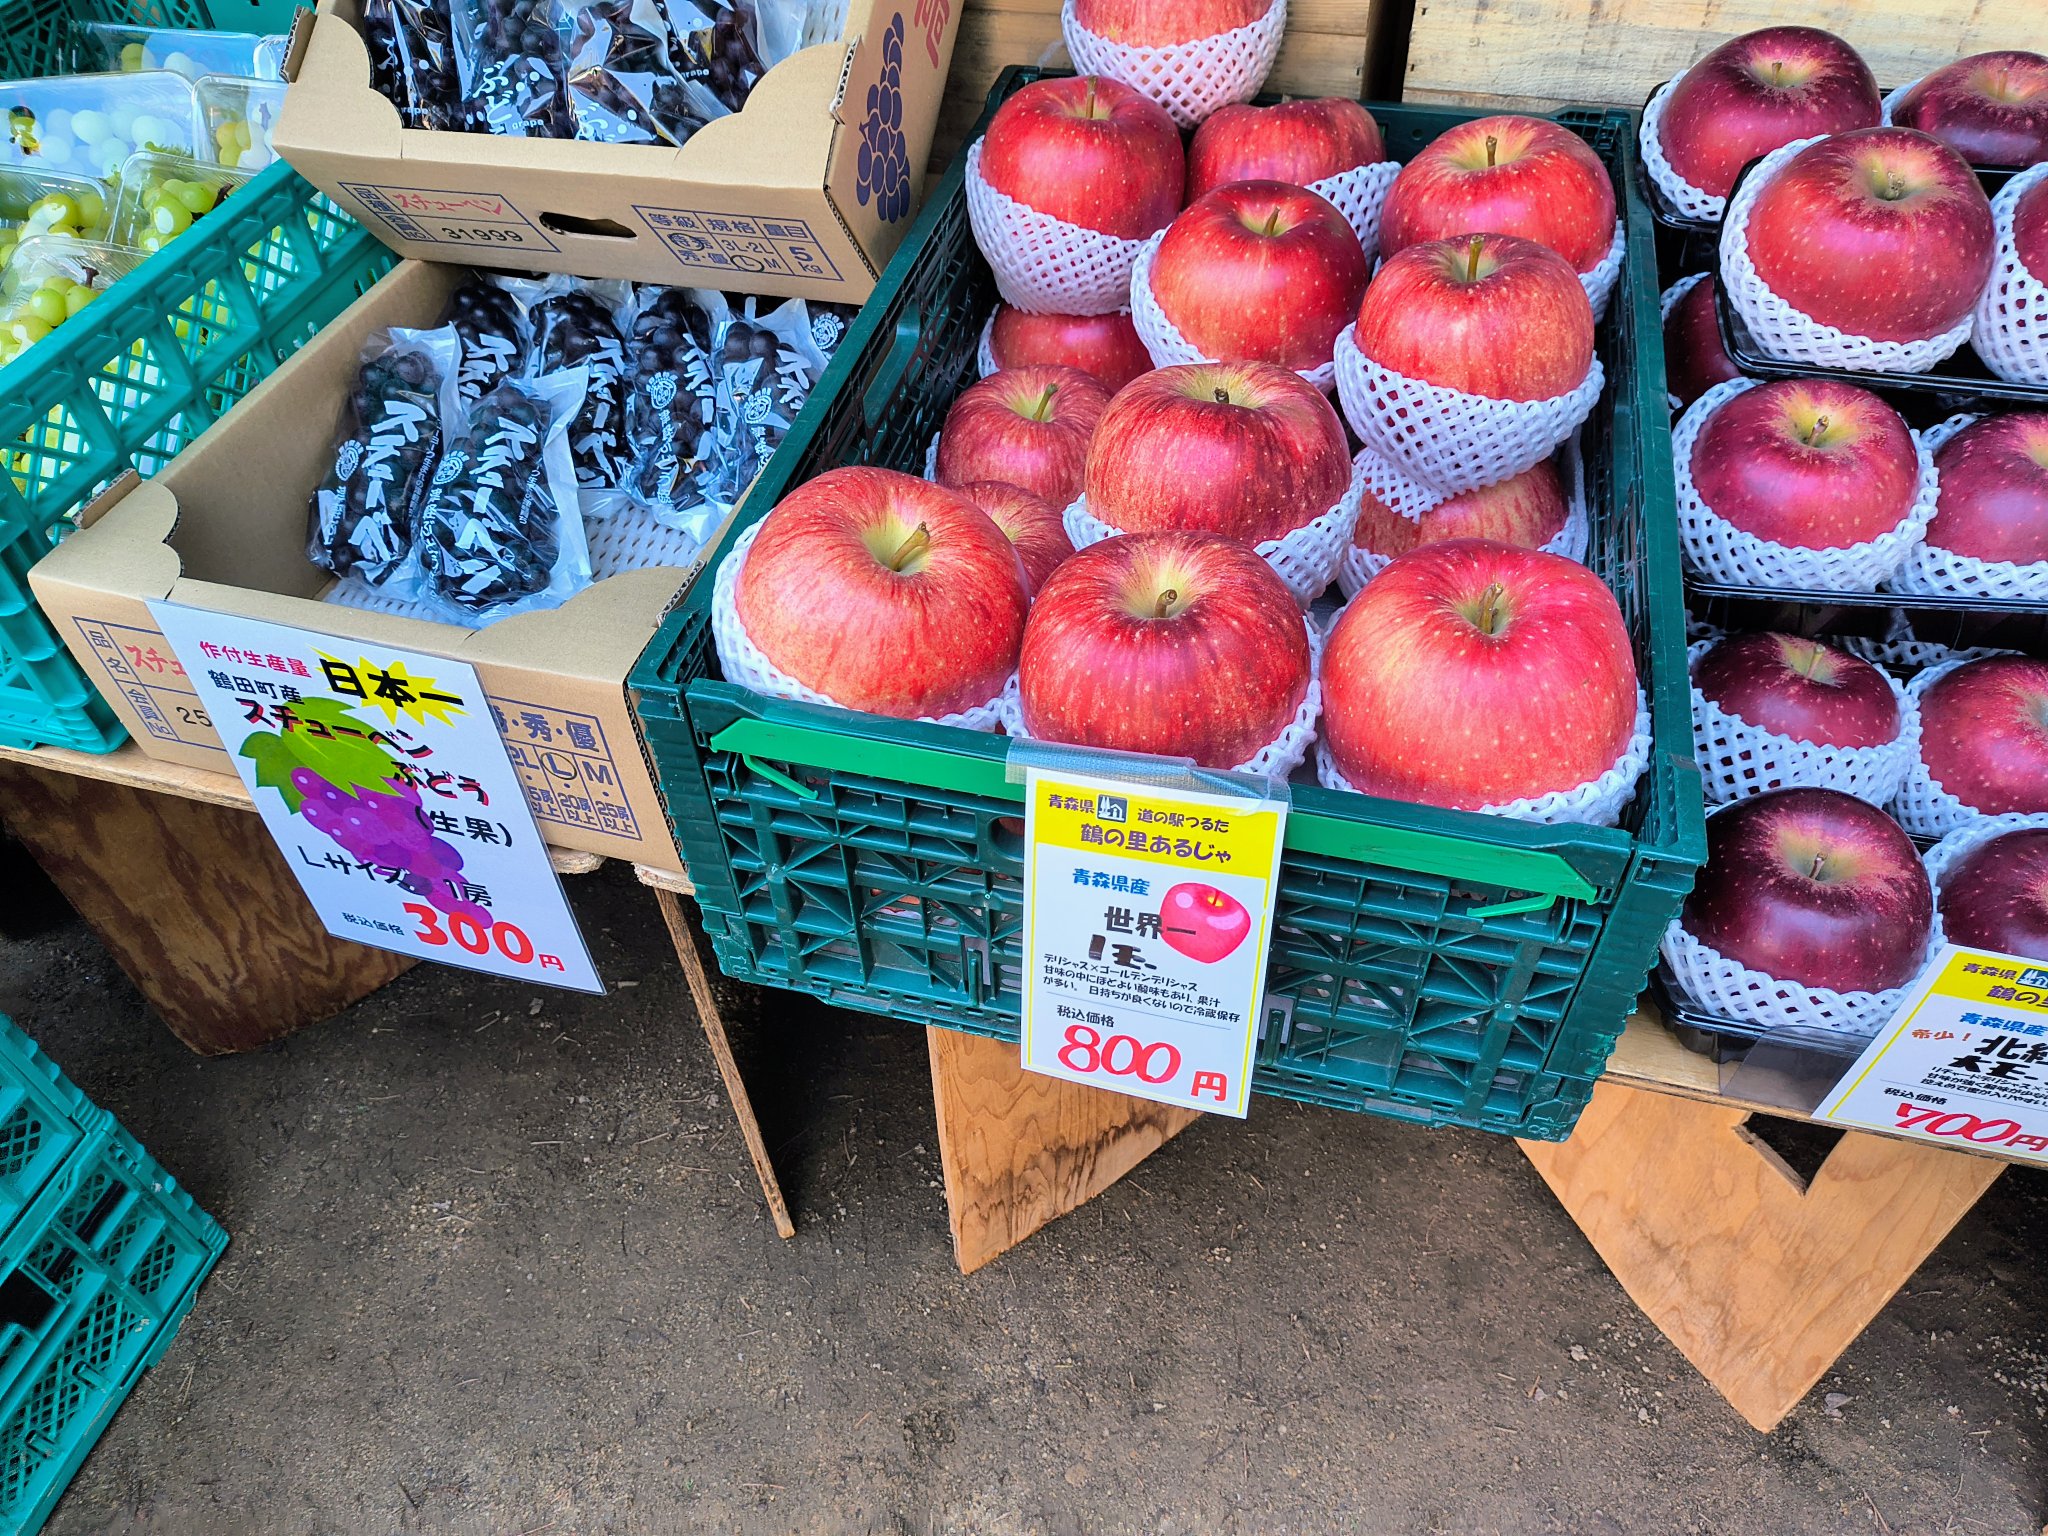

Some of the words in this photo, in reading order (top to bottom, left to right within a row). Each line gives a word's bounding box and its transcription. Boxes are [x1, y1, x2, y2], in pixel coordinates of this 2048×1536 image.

[647, 212, 700, 229] 等級
[706, 218, 757, 234] 規格
[441, 227, 524, 243] 31999
[764, 257, 782, 270] M
[789, 246, 814, 262] 5
[199, 640, 313, 679] 作付生産量
[207, 669, 306, 706] 鶴田町産
[318, 658, 465, 708] 日本一
[176, 706, 214, 728] 25
[235, 697, 434, 760] スチューベン
[545, 752, 573, 777] L
[581, 760, 614, 786] M
[390, 760, 490, 807] ぶどう
[557, 792, 592, 813] 20房
[595, 800, 630, 822] 25房
[1047, 793, 1095, 814] 青森県
[1136, 807, 1230, 834] 道の駅つるた
[565, 809, 598, 827] 以上
[602, 817, 636, 835] 以上
[1080, 823, 1232, 864] 鶴の里あるじゃ
[297, 845, 414, 890] Lサイズ
[442, 878, 493, 908] 1房
[1072, 867, 1151, 897] 青森県産
[341, 911, 406, 937] 税込価格
[1103, 905, 1197, 940] 世界一
[1961, 962, 2019, 981] 青森県
[1056, 1004, 1116, 1028] 税込価格
[1958, 1012, 2048, 1037] 青森県産
[1883, 1087, 1948, 1105] 税込価格
